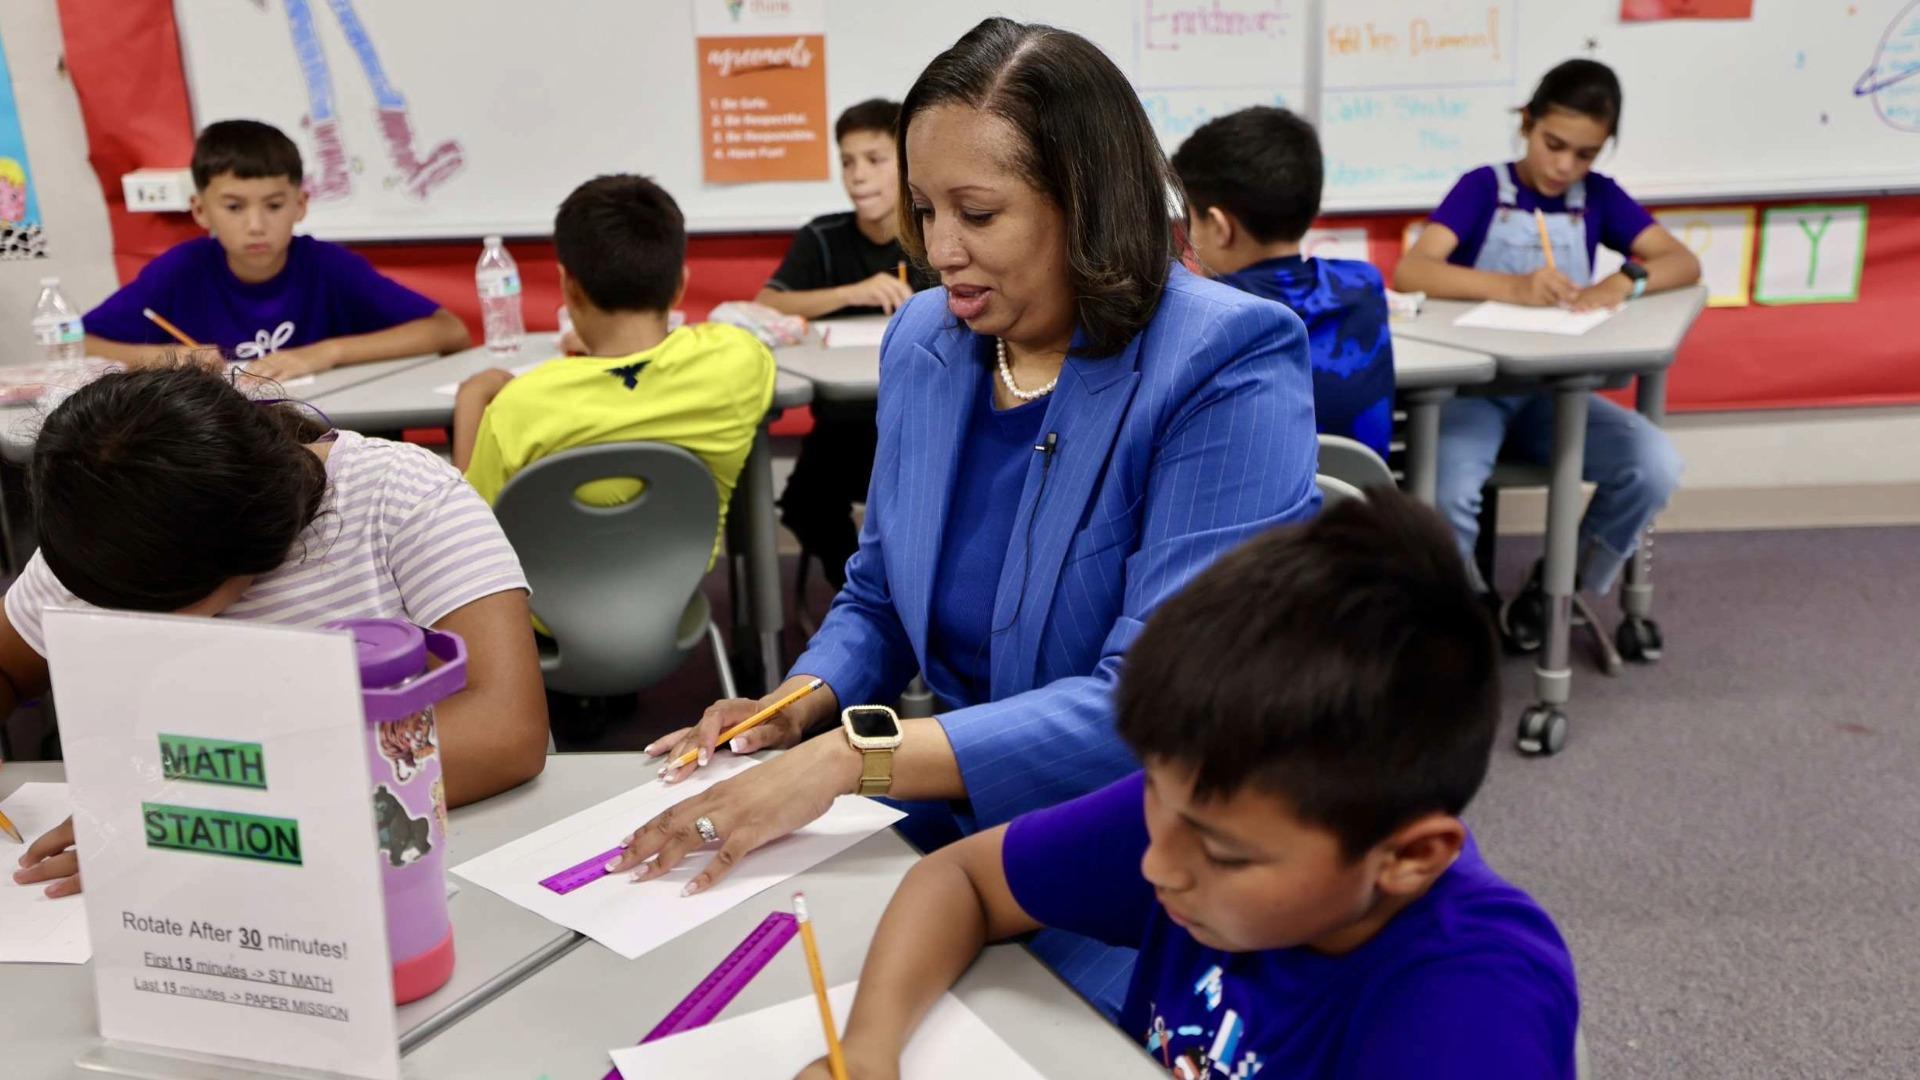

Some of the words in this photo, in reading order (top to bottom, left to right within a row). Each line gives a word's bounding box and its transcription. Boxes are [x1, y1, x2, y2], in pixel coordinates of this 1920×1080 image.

[707, 37, 813, 76] agreements
[1798, 214, 1832, 288] Y
[161, 742, 265, 784] MATH
[145, 810, 300, 859] STATION
[122, 911, 183, 936] Rotate
[189, 921, 232, 944] After
[239, 927, 262, 948] 30
[268, 932, 348, 960] minutes!
[144, 952, 172, 970] First
[178, 957, 192, 971] 15
[196, 960, 247, 980] minutes
[269, 969, 287, 985] ST
[292, 974, 333, 993] MATH
[134, 977, 159, 993] Last
[163, 982, 176, 995] 15
[180, 985, 226, 1002] minutes
[245, 992, 289, 1011] PAPER
[292, 1000, 349, 1021] MISSION
